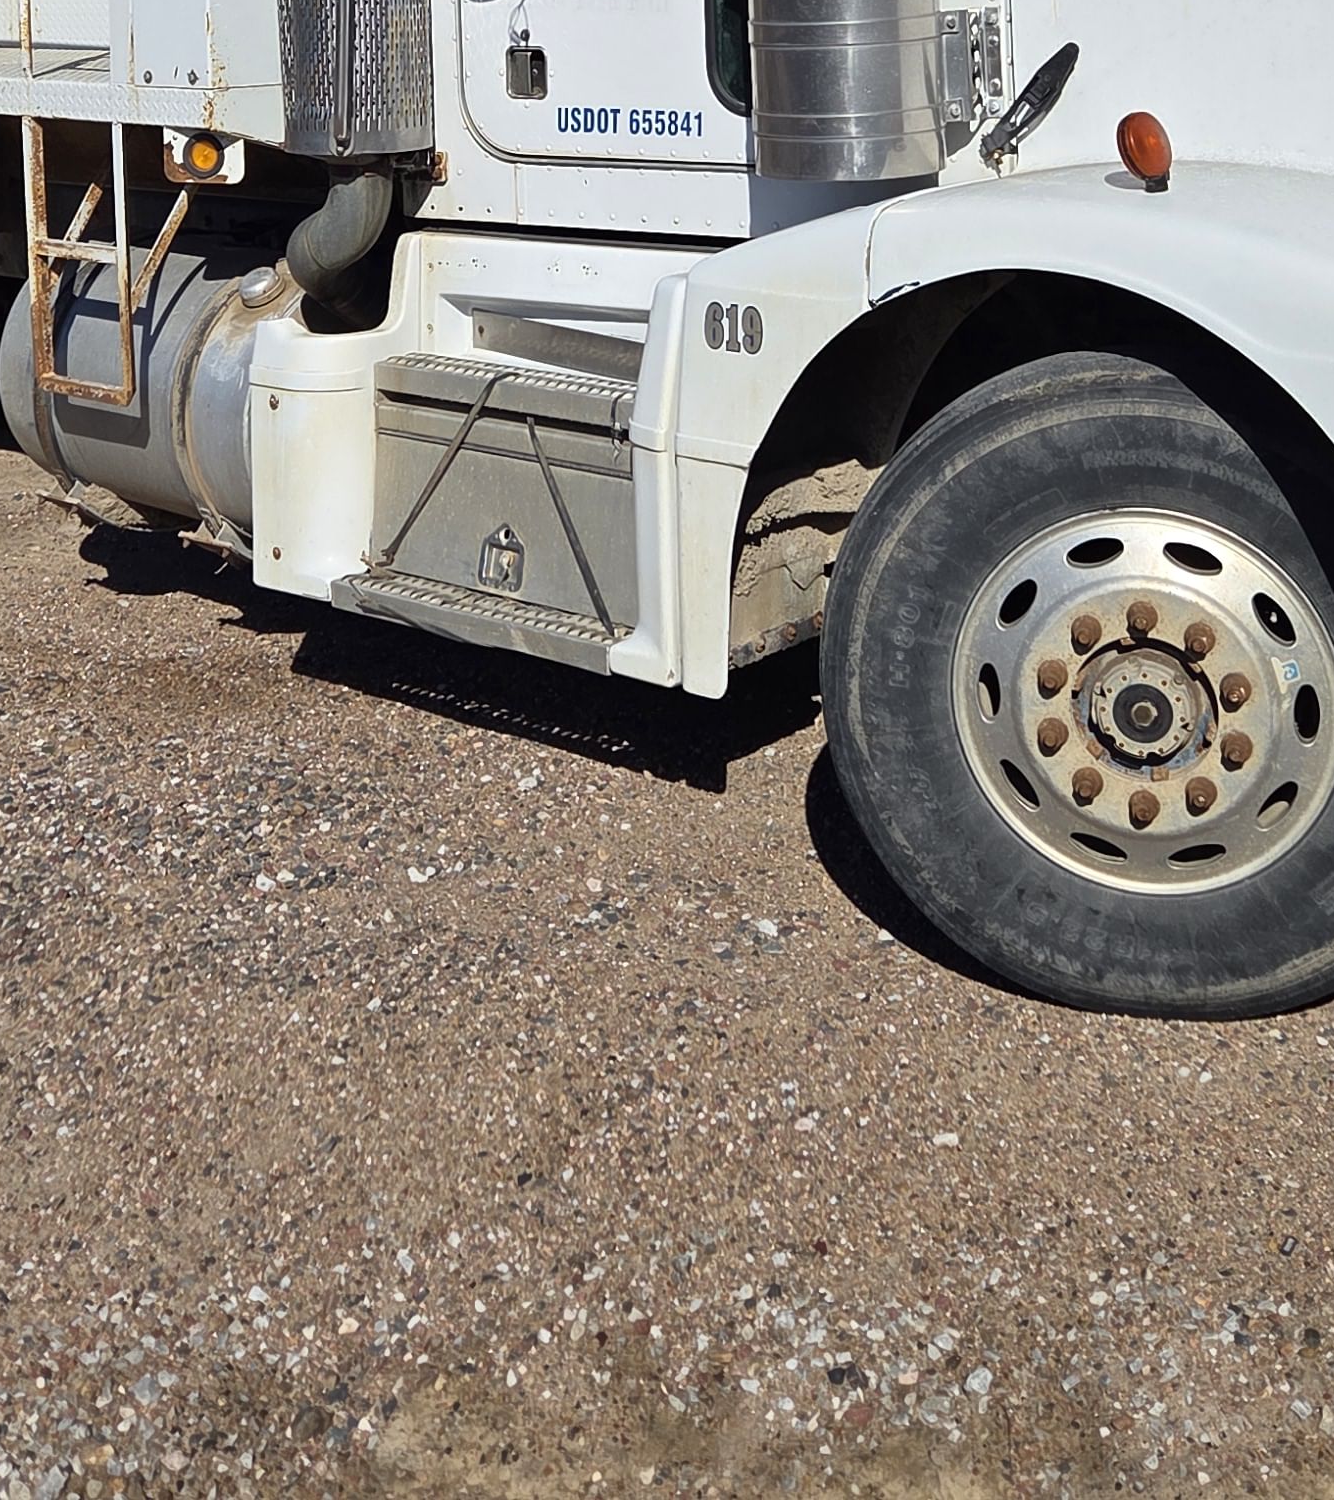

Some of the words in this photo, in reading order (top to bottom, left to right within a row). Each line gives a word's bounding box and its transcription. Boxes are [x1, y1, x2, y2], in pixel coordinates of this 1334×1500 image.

[557, 107, 621, 134] USDOT
[629, 108, 704, 137] 655841
[704, 301, 763, 355] 619
